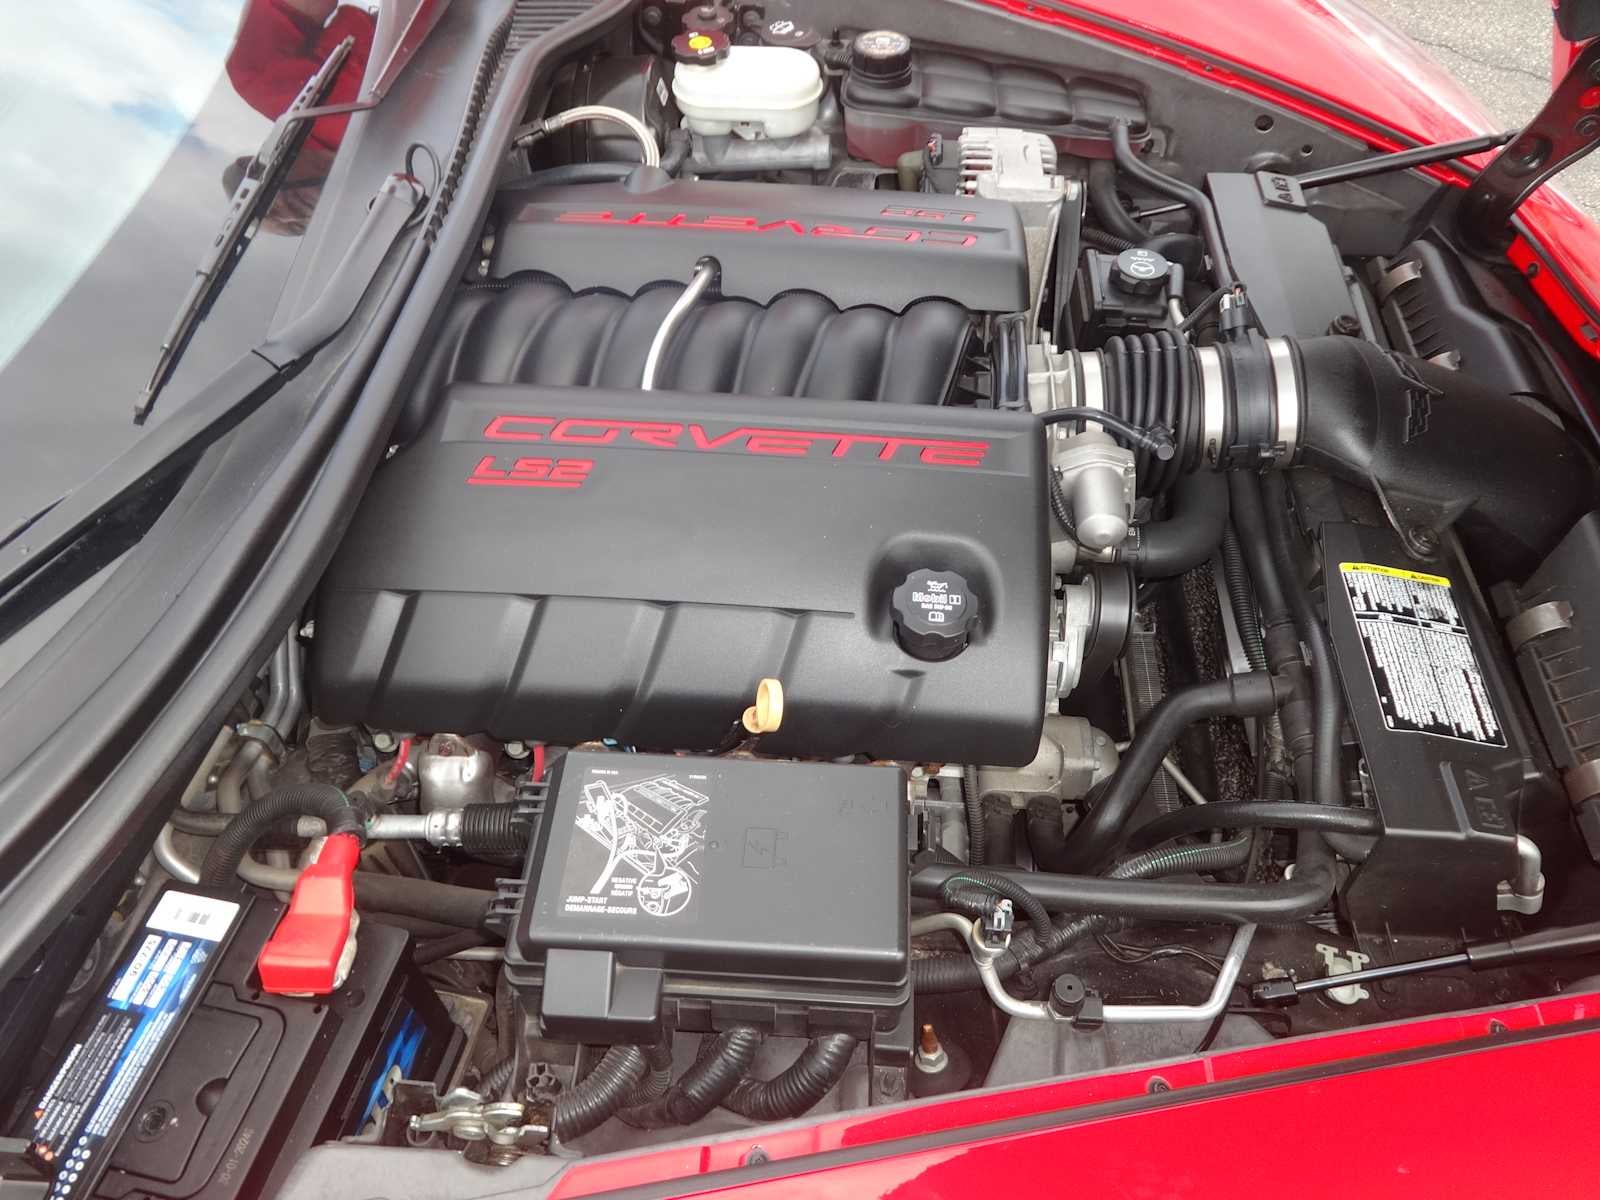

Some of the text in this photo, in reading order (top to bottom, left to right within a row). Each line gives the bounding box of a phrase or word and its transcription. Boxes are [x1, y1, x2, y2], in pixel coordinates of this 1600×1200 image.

[556, 211, 977, 246] CORVETTE
[881, 205, 977, 222] LS2
[483, 415, 991, 467] CORVETTE
[466, 456, 594, 488] LS2
[566, 895, 608, 904] JUMP-START
